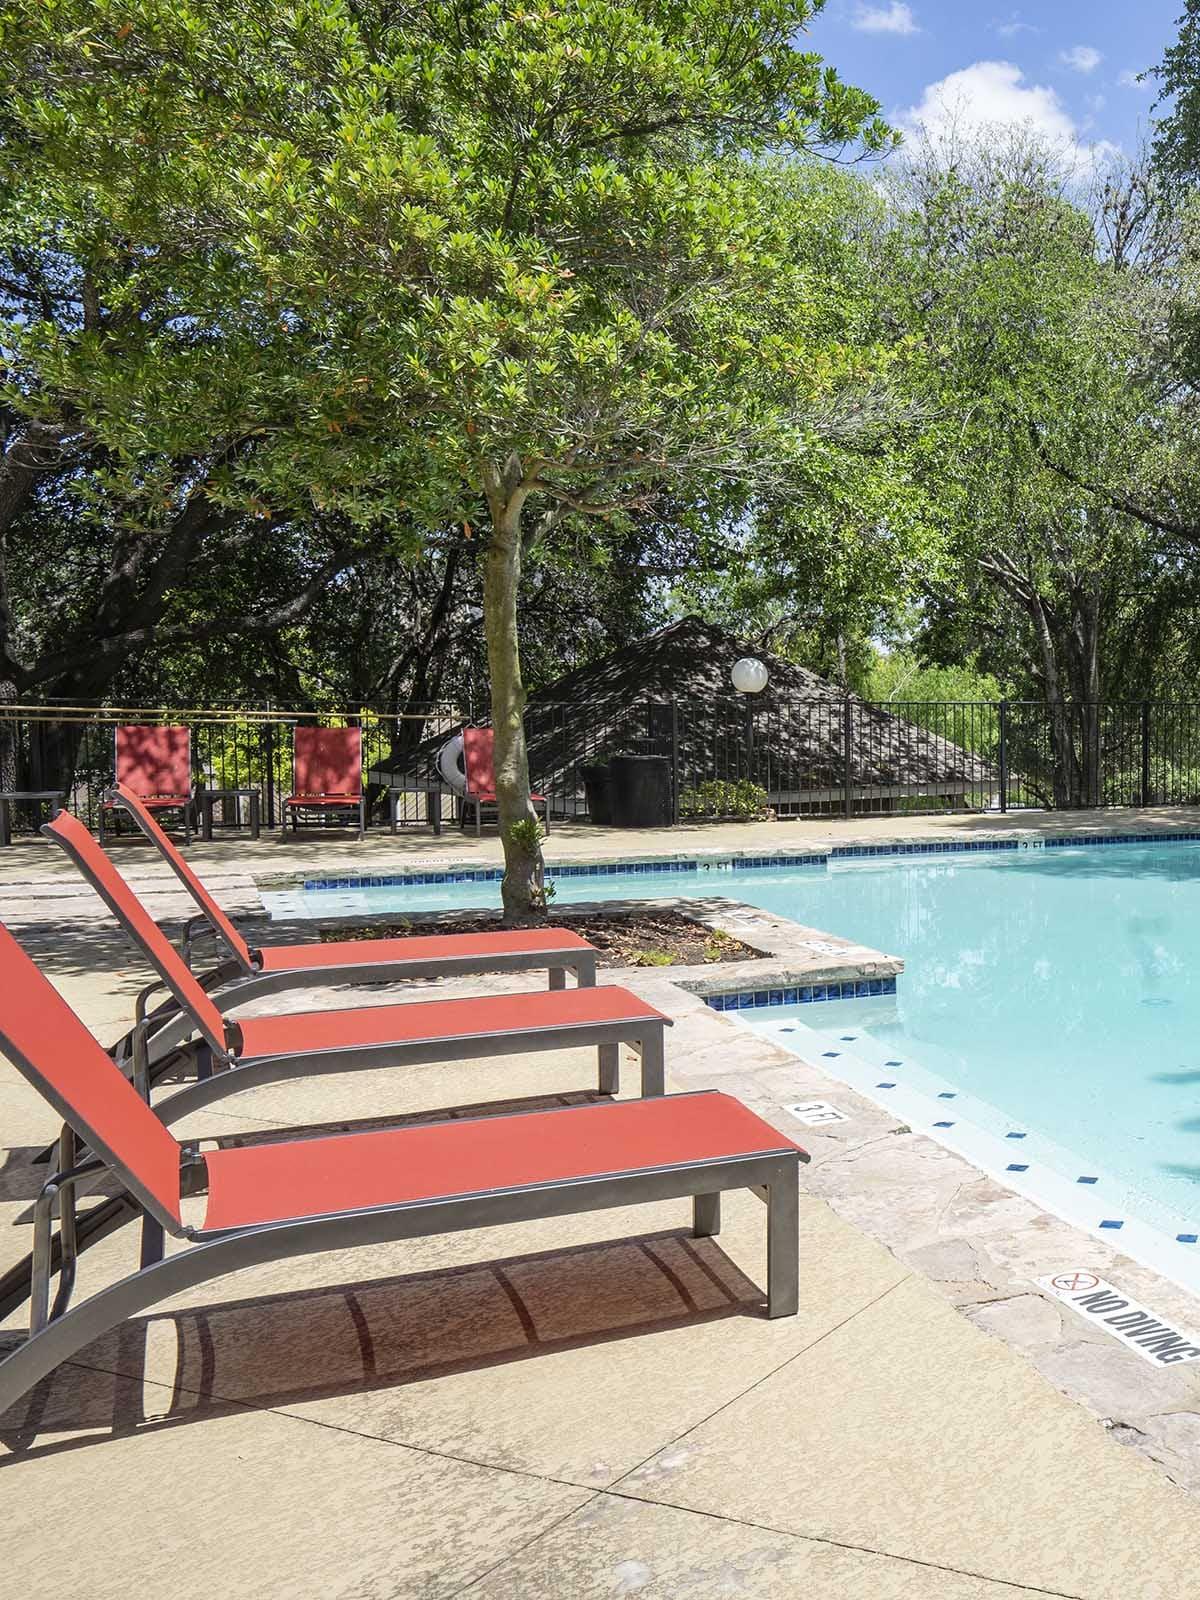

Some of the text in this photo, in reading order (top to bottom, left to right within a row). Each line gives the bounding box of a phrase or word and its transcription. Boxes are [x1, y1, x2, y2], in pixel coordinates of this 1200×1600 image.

[794, 1104, 844, 1122] 3 FT
[1071, 1289, 1129, 1314] NO
